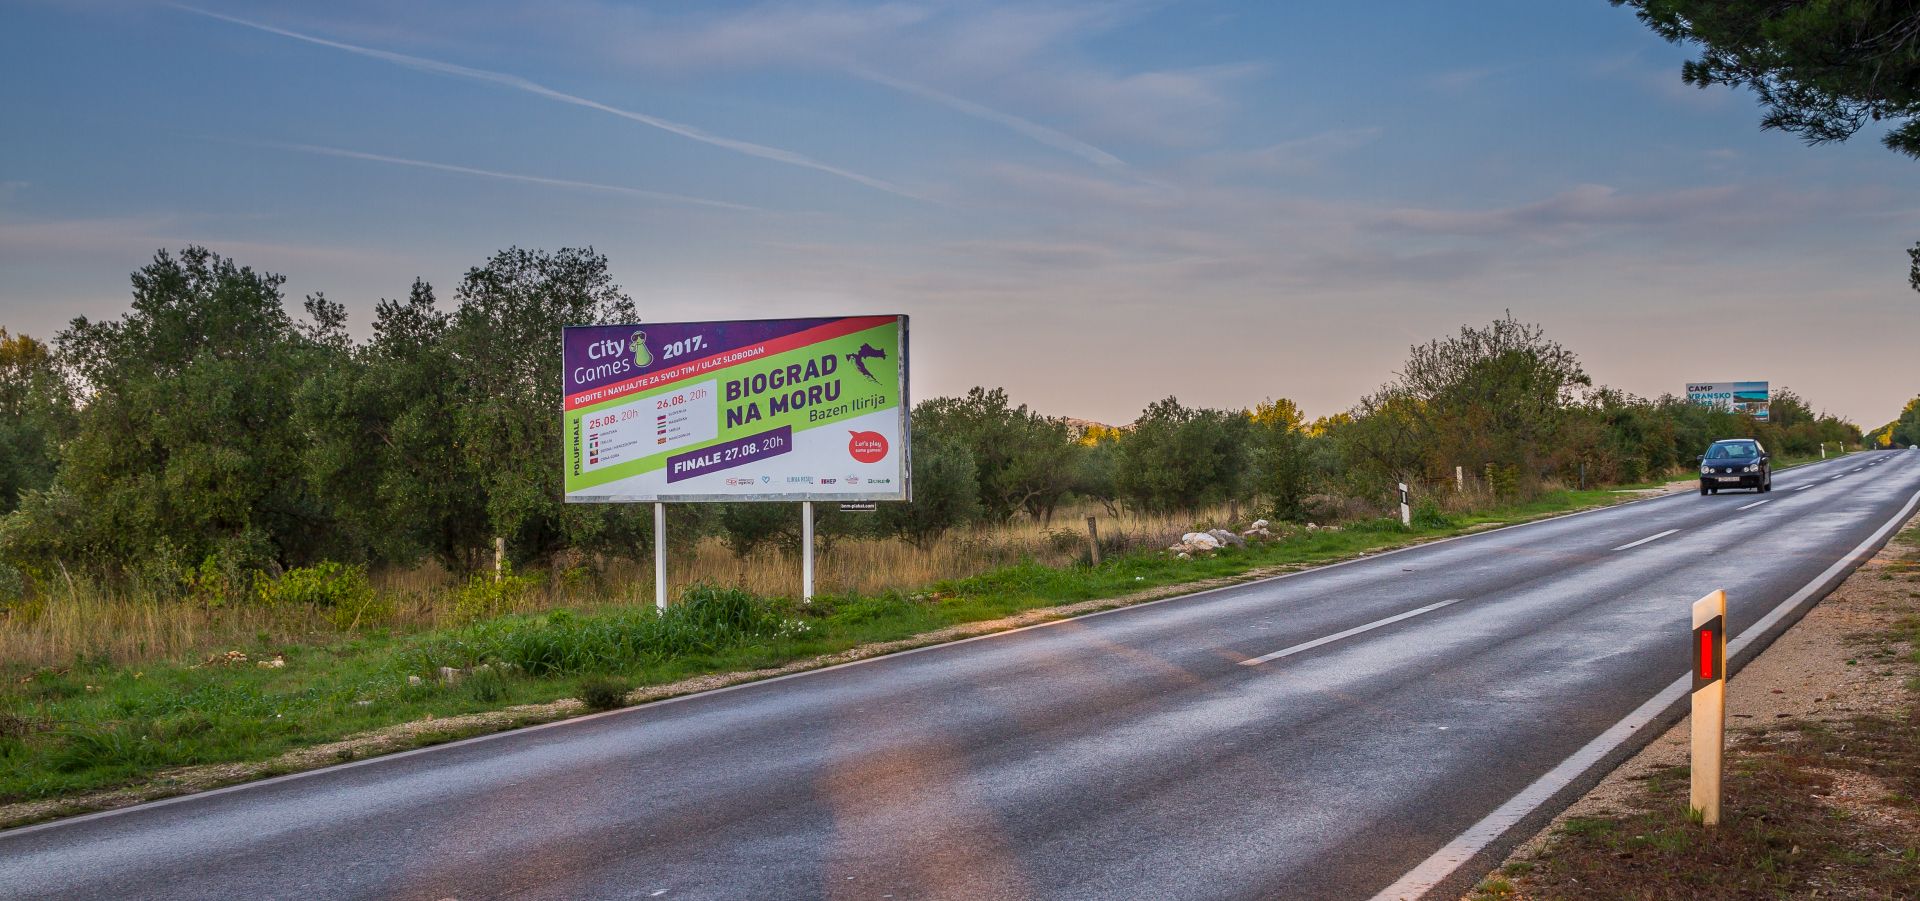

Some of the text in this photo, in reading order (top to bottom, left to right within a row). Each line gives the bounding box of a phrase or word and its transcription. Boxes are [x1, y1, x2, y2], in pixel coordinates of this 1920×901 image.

[588, 338, 625, 360] City
[663, 335, 708, 360] 2017.
[574, 358, 630, 384] Games
[603, 389, 607, 397] I
[608, 378, 648, 396] NAVIJAJTE
[649, 375, 660, 385] ZA
[661, 370, 680, 382] SVOJ
[681, 366, 695, 376] TIM
[701, 357, 721, 369] ULAZ
[723, 346, 764, 364] SLOBODAN
[725, 354, 838, 402] BIOGRAD
[657, 389, 707, 410] 26.08. 20h
[726, 379, 841, 429] NA MORU
[809, 394, 885, 422] Bazen Ilirija
[1689, 392, 1731, 400] VRANSKO
[589, 408, 639, 430] 25.08. 20h
[674, 435, 784, 475] FINALE 27.08. 20h
